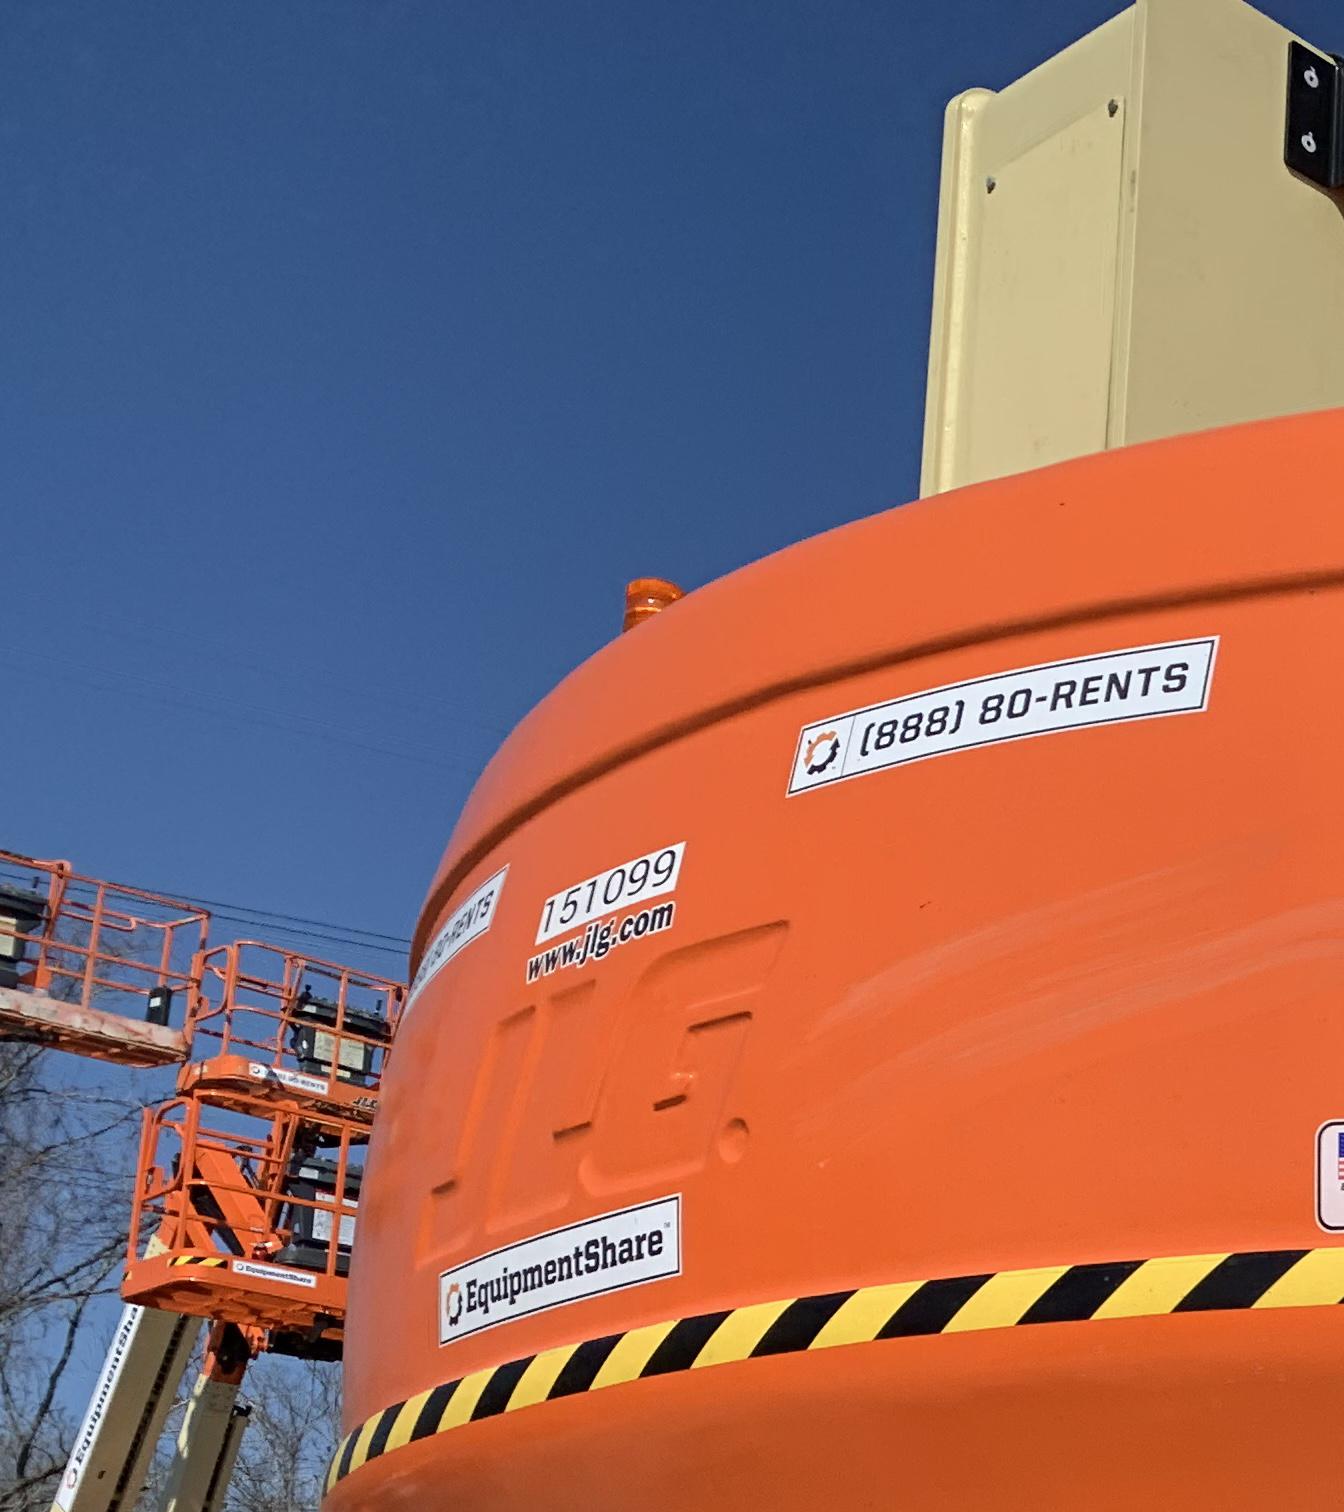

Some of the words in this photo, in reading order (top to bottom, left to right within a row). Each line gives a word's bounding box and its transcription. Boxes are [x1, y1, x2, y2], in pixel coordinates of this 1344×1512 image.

[859, 700, 965, 758] (888)
[978, 661, 1190, 727] 80-RENTS
[542, 849, 677, 934] 151099
[526, 902, 675, 982] www.jlg.com
[465, 1225, 664, 1314] EquipmentShare
